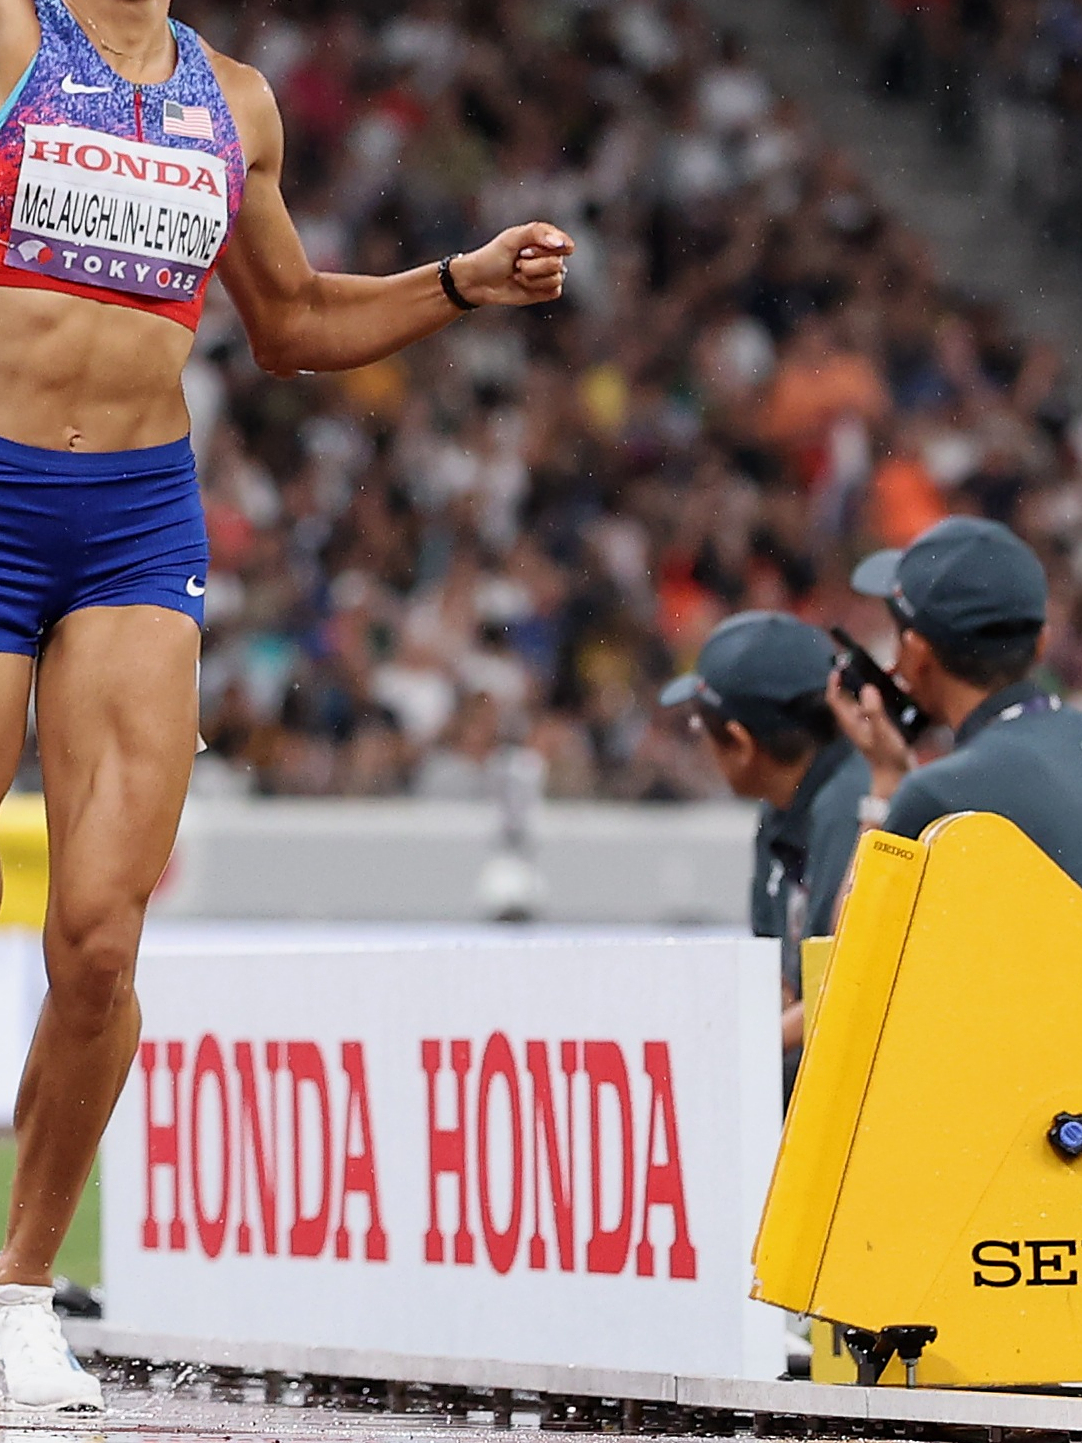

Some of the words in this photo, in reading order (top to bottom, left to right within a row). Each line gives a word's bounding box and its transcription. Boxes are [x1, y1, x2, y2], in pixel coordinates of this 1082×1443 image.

[28, 139, 222, 197] HONDA
[19, 183, 221, 261] McLAUGHLIN-LEVRONE
[140, 1032, 389, 1262] HONDA
[421, 1029, 697, 1280] HONDA
[971, 1239, 1082, 1288] SE
